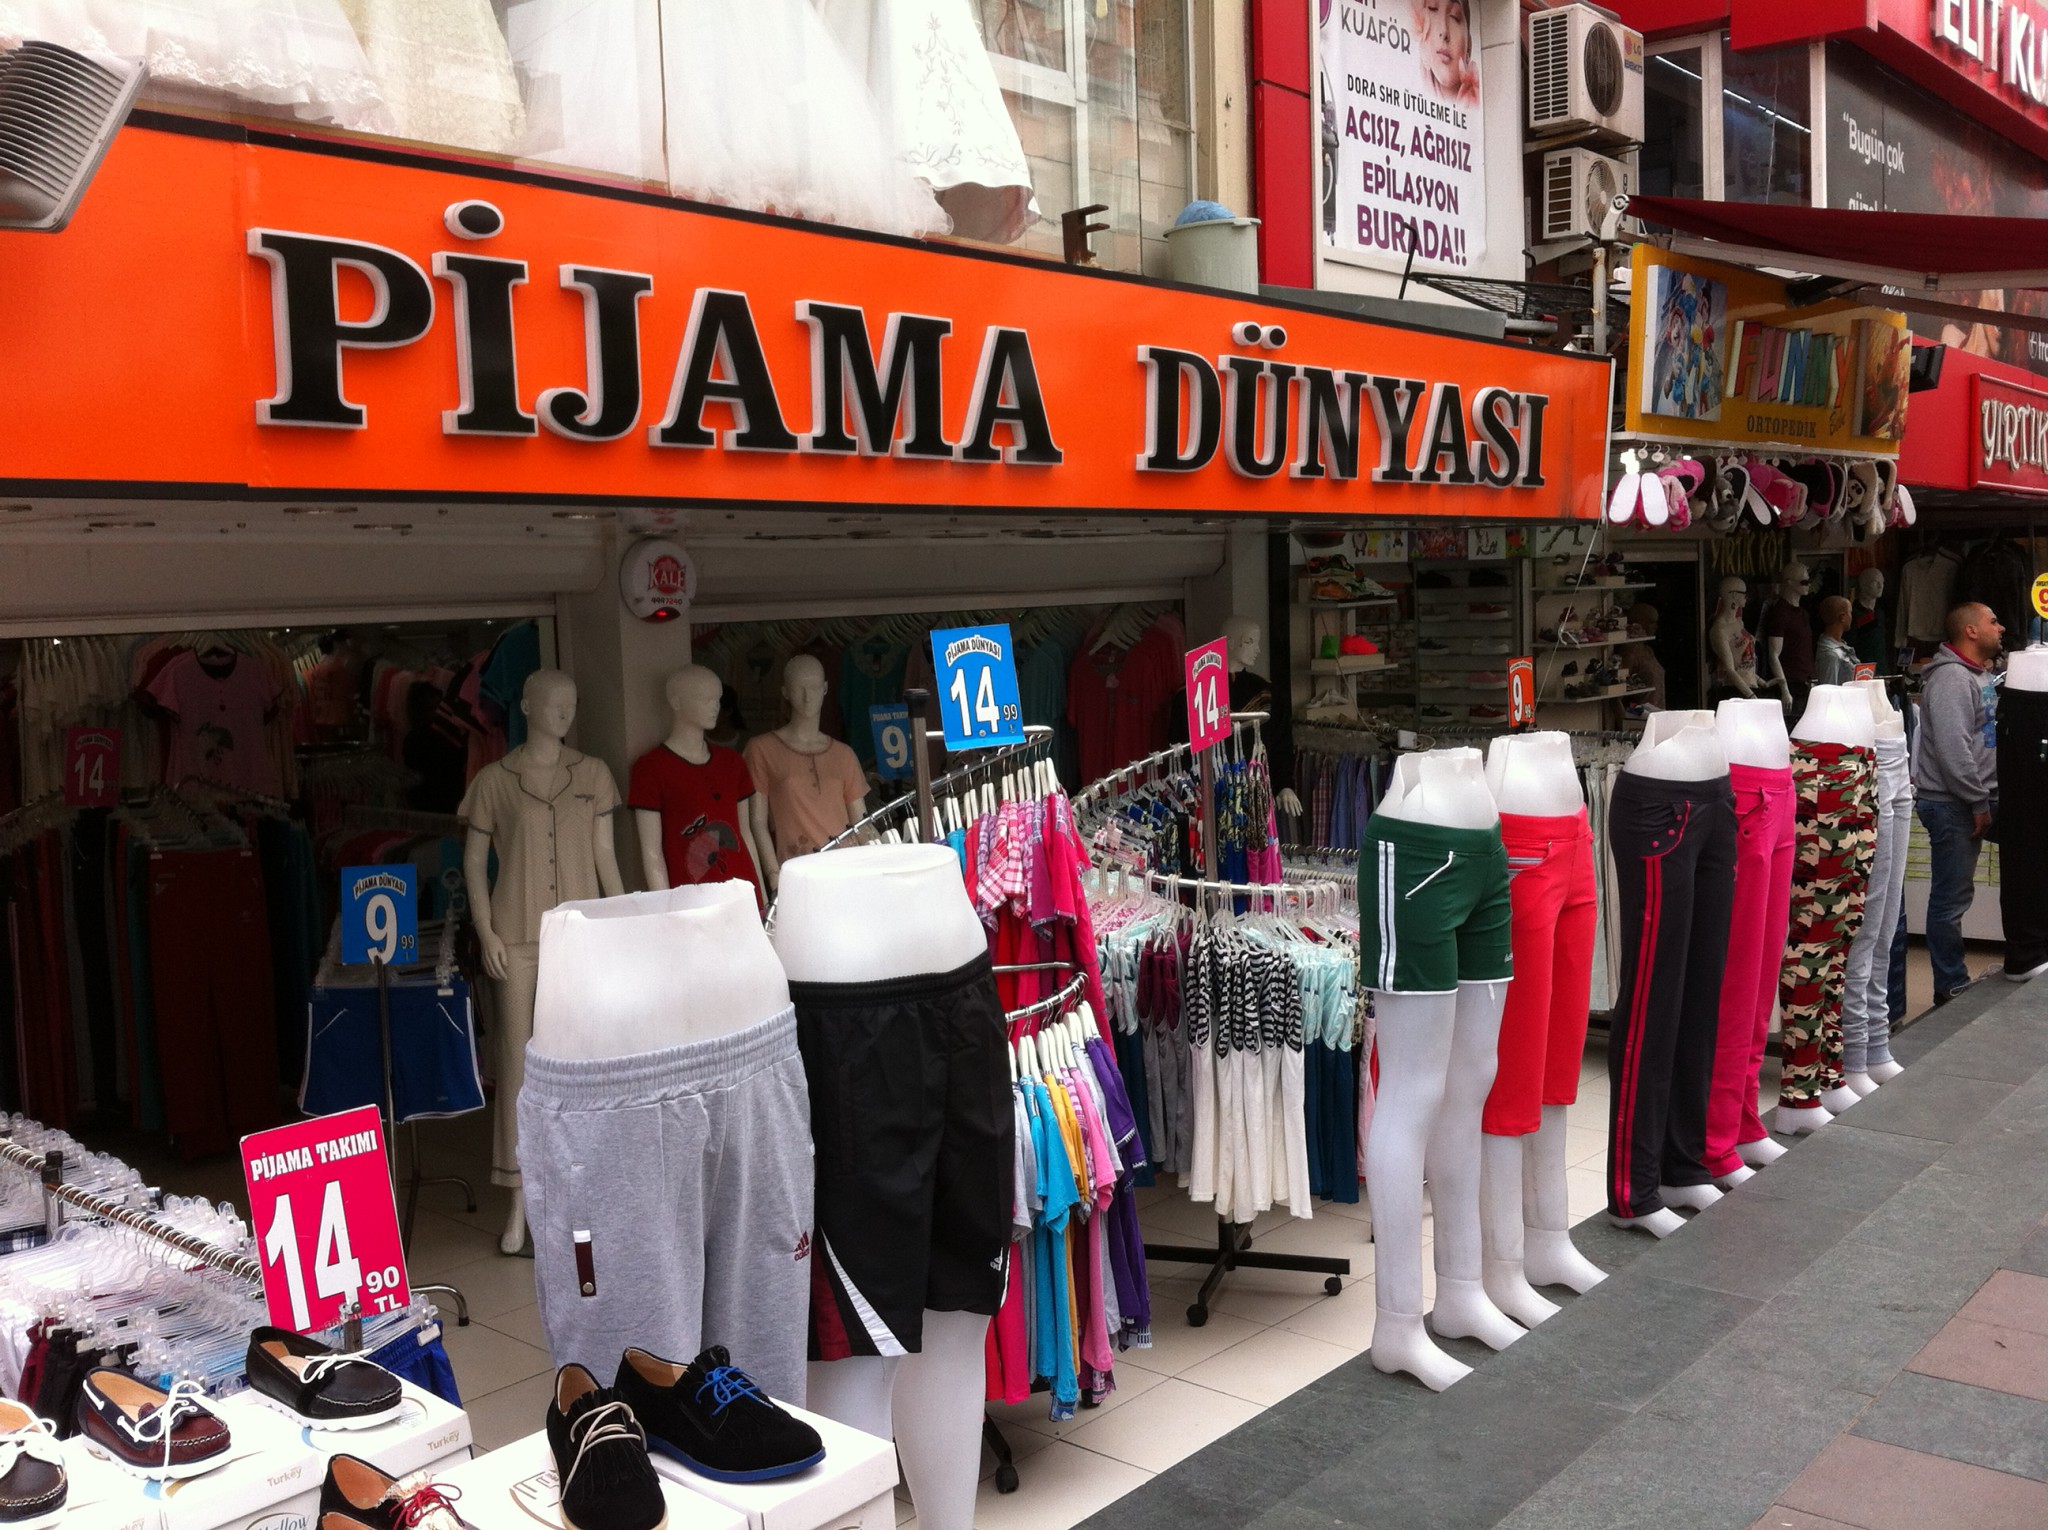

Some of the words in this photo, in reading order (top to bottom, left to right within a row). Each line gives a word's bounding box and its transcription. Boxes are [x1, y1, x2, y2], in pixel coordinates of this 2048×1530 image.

[1340, 4, 1411, 54] KUAFÖR
[1347, 74, 1377, 99] DORA
[1379, 84, 1400, 107] SHR
[1403, 88, 1451, 124] ÜTÜLEME
[1453, 104, 1467, 130] İLE
[1345, 105, 1406, 158] ACISIZ,
[1410, 124, 1472, 173] AĞRISIZ
[1886, 142, 1905, 175] çok
[1362, 155, 1459, 215] EPİLASYON
[1357, 204, 1468, 267] BURADA!!
[246, 199, 1064, 466] PİJAMA
[1136, 321, 1550, 488] DÜNYASI
[1725, 320, 1856, 409] FUNNY
[1746, 415, 1817, 438] ORTOPEDİK
[648, 564, 686, 592] KALE
[946, 642, 970, 664] PİJAMA
[971, 637, 1001, 659] DÜNYASI
[950, 665, 1000, 736] 14
[1003, 703, 1018, 721] 99
[1194, 675, 1219, 738] 14
[1512, 674, 1523, 722] 9
[882, 725, 908, 768] 9
[74, 752, 105, 797] 14
[365, 893, 398, 965] 9
[401, 934, 415, 950] 99
[250, 1146, 314, 1182] PİJAMA
[315, 1129, 378, 1164] TAKIMI
[264, 1180, 363, 1332] 14
[366, 1265, 401, 1294] 90
[374, 1293, 402, 1313] TL
[427, 1430, 460, 1451] Turkey
[266, 1466, 302, 1488] Turkey
